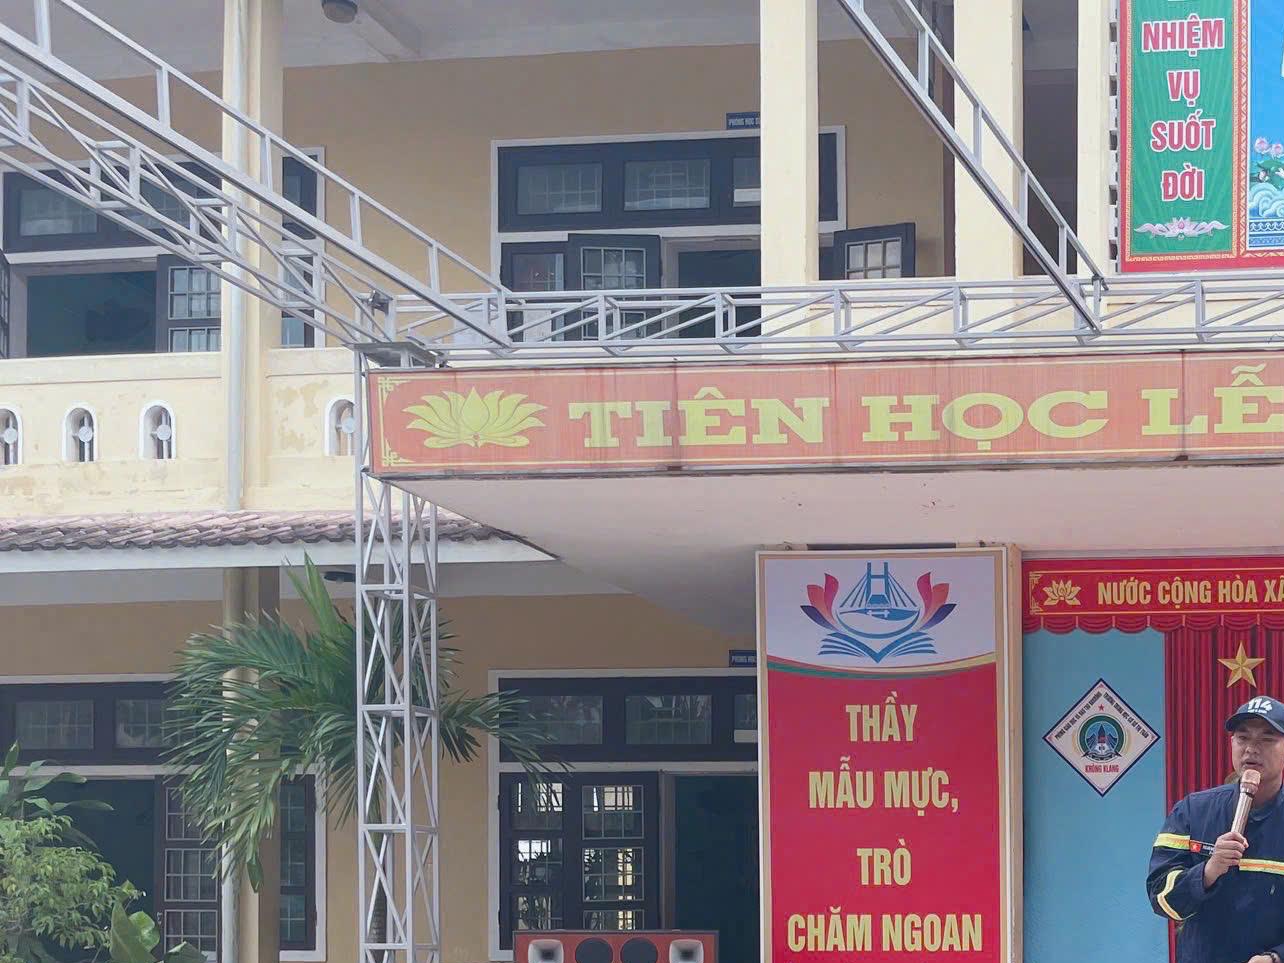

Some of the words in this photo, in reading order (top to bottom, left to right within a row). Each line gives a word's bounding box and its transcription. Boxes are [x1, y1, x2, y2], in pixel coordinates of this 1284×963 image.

[1142, 13, 1225, 57] NHIỆM
[1167, 69, 1200, 107] VỤ
[1150, 109, 1216, 152] SUỐT
[1161, 162, 1204, 201] ĐỜI
[568, 386, 829, 448] TIÊN
[861, 390, 1108, 451] HỌC
[1141, 363, 1284, 436] LỄ
[1098, 577, 1151, 605] NƯỚC
[1158, 576, 1212, 609] CỘNG
[1218, 574, 1257, 603] HÒA
[846, 691, 918, 742] THẦY
[1248, 698, 1272, 712] 114
[808, 755, 874, 809] MẪU
[884, 767, 959, 817] MỰC,
[856, 838, 912, 886] TRÒ
[787, 906, 872, 952] CHĂM
[882, 914, 982, 952] NGOAN
